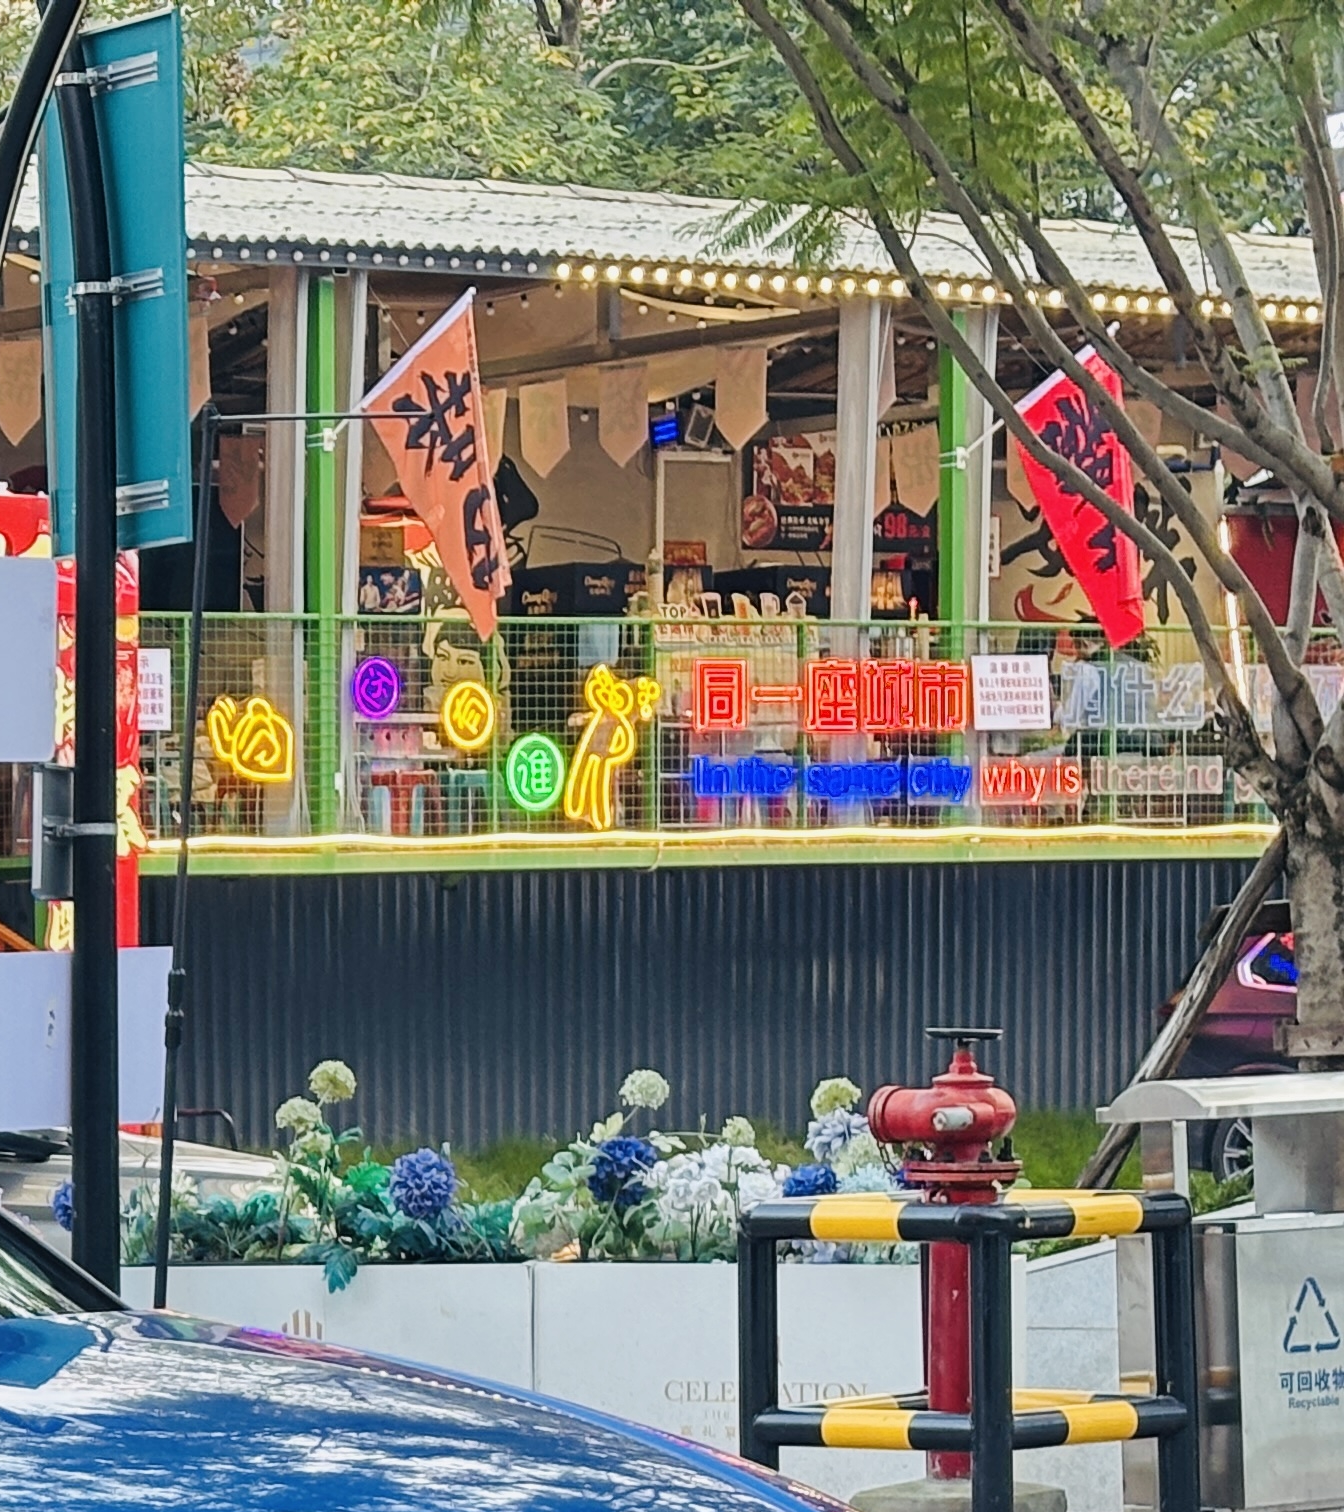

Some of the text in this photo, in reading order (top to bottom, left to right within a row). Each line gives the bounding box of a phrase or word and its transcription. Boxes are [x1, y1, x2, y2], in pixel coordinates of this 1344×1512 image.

[660, 605, 687, 619] TOP
[693, 657, 968, 733] 同一座城市
[1061, 662, 1206, 728] 为什么
[910, 758, 972, 802] city
[983, 762, 1048, 802] why
[1055, 757, 1081, 794] is
[1093, 760, 1175, 792] there
[1288, 1394, 1340, 1412] Recyclable
